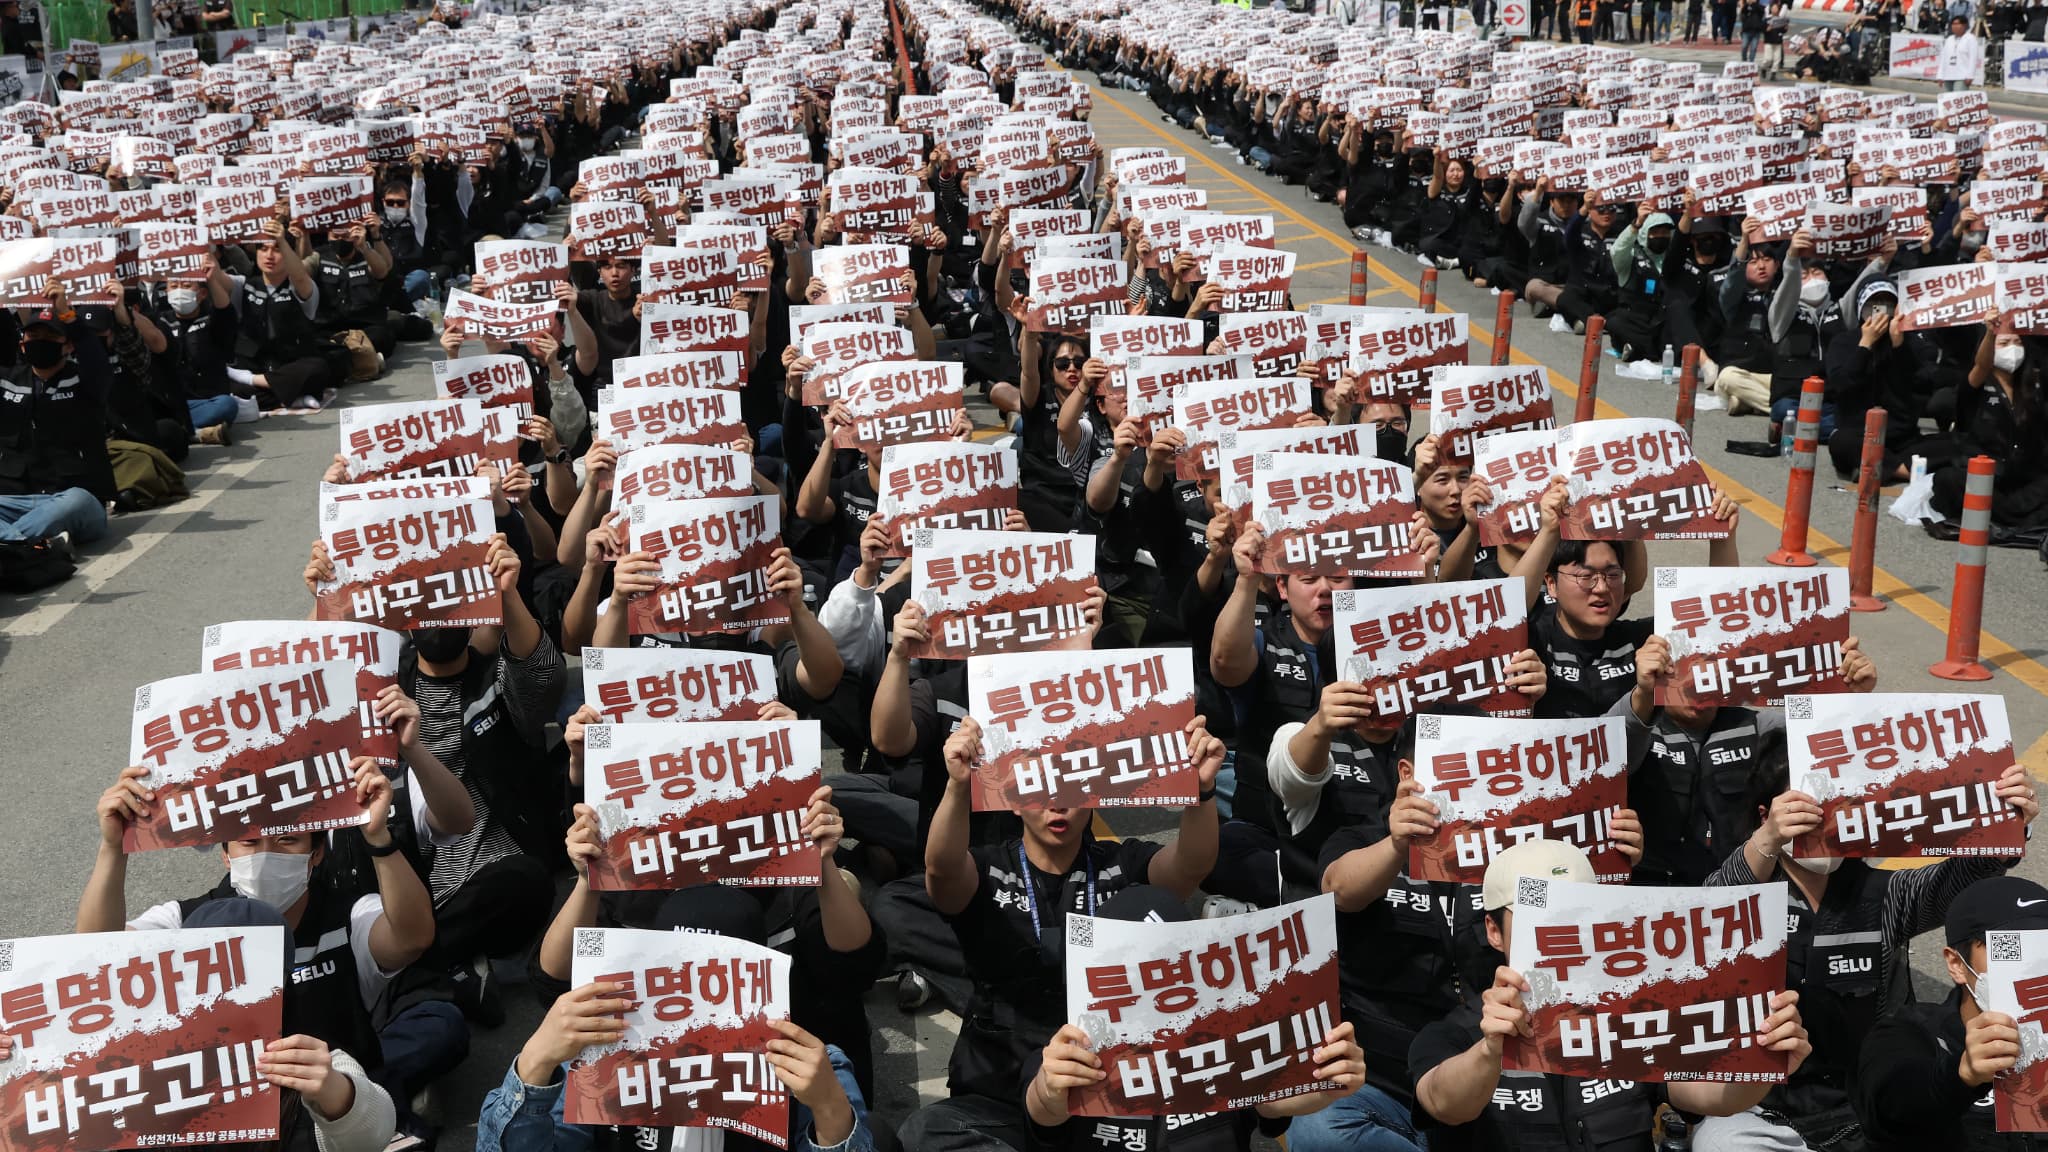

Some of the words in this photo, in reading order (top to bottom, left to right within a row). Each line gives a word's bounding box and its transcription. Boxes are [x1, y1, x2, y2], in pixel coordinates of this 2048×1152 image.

[650, 113, 689, 133] 투명하게
[1487, 103, 1528, 123] 투명하게
[1567, 112, 1608, 129] 투명하게
[200, 119, 242, 138] 투명하게
[1606, 131, 1651, 149] 투명하게
[308, 133, 360, 152] 투명하게
[753, 142, 802, 160] 투명하게
[849, 142, 901, 167] 투명하게
[985, 144, 1041, 168] 투명하게
[1664, 133, 1710, 153] 투명하게
[1744, 140, 1800, 161] 투명하게
[1892, 140, 1949, 161] 투명하게
[314, 154, 367, 174] 바꾸고!!!
[583, 159, 640, 186] 투명하게
[1125, 160, 1179, 183] 투명하게
[1592, 158, 1645, 184] 투명하게
[1989, 153, 2039, 173] 투명하게
[838, 178, 908, 201] 투명하게
[1003, 168, 1062, 199] 투명하게
[1695, 163, 1755, 191] 투명하게
[40, 195, 110, 219] 투명하게
[202, 190, 265, 218] 투명하게
[294, 183, 353, 209] 투명하게
[709, 184, 776, 211] 투명하게
[1138, 191, 1199, 211] 투명하게
[1753, 187, 1818, 216] 투명하게
[1976, 186, 2035, 208] 투명하게
[575, 205, 638, 233] 투명하게
[844, 207, 913, 229] 바꾸고!!!
[1015, 212, 1083, 241] 투명하게
[1811, 209, 1884, 233] 투명하게
[482, 246, 558, 277] 투명하게
[649, 251, 728, 283] 투명하게
[1216, 254, 1286, 279] 투명하게
[1037, 264, 1118, 296] 투명하게
[1906, 266, 1986, 302] 투명하게
[457, 299, 545, 321] 투명하게
[1221, 290, 1284, 312] 바꾸고!!!
[1916, 295, 1993, 327] 바꾸고!!!
[464, 317, 551, 338] 바꾸고!!!
[650, 313, 738, 344] 투명하게
[1100, 321, 1191, 353] 투명하게
[1224, 315, 1308, 353] 투명하게
[1359, 317, 1457, 360] 투명하게
[811, 330, 904, 366] 투명하게
[445, 360, 528, 399] 투명하게
[847, 365, 949, 403] 투명하게
[1441, 369, 1545, 417] 투명하게
[609, 394, 727, 440] 투명하게
[1184, 382, 1297, 430] 투명하게
[349, 403, 466, 461] 투명하게
[619, 454, 736, 504] 투명하게
[888, 451, 1004, 502] 투명하게
[1267, 467, 1403, 516] 투명하게
[1590, 483, 1716, 533] 바꾸고!!
[331, 503, 478, 568] 투명하게
[926, 539, 1074, 596] 투명하게
[352, 564, 497, 623] 바꾸고!!!
[660, 566, 777, 625] 바꾸고!!
[1671, 574, 1830, 639] 투명하게
[943, 602, 1087, 653] 바꾸고!!!
[1350, 584, 1506, 661] 투명하게
[1274, 663, 1307, 682] 투쟁
[1600, 664, 1635, 681] SELU
[1692, 640, 1842, 699] 바꾸고!!!
[598, 658, 760, 724] 투명하게
[987, 655, 1169, 733] 투명하게
[1375, 651, 1523, 717] 바꾸고!!
[143, 669, 330, 768] 투명하게
[474, 711, 501, 736] SELU
[1651, 740, 1685, 766] 투쟁
[1806, 700, 1988, 779] 투명하게
[603, 727, 796, 810] 투명하게
[1014, 730, 1192, 800] 바꾸고!!!
[1432, 724, 1610, 802] 투명하게
[1711, 747, 1751, 765] SELU
[1333, 763, 1371, 784] 투쟁
[164, 748, 359, 836] 바꾸고!!!
[1099, 797, 1155, 808] 삼성전자노동조합
[1156, 796, 1198, 806] 공동투쟁본부
[260, 820, 321, 837] 삼성전자노동조합
[1920, 848, 1978, 858] 삼성전자노동조합
[1979, 847, 2024, 857] 공동투쟁본부
[776, 874, 820, 886] 공동투쟁본부
[993, 887, 1031, 913] 투쟁
[1384, 888, 1431, 913] 투쟁
[1534, 893, 1762, 983] 투명하게
[291, 960, 336, 985] SELU
[1085, 909, 1310, 1024] 투명하게
[1829, 956, 1873, 976] SELU
[1, 935, 247, 1048] 투명하게
[24, 1038, 271, 1140] 바꾸고!!!
[1663, 1070, 1733, 1083] 삼성전자노동조합
[1734, 1071, 1785, 1083] 공동투쟁본부
[1227, 1085, 1293, 1109] 삼성전자노동조합
[1492, 1088, 1543, 1112] 투쟁
[1581, 1080, 1636, 1104] SELU
[136, 1131, 216, 1146] 삼성전자노동조합
[217, 1127, 276, 1143] 공동투쟁본부
[1092, 1123, 1147, 1152] 투쟁
